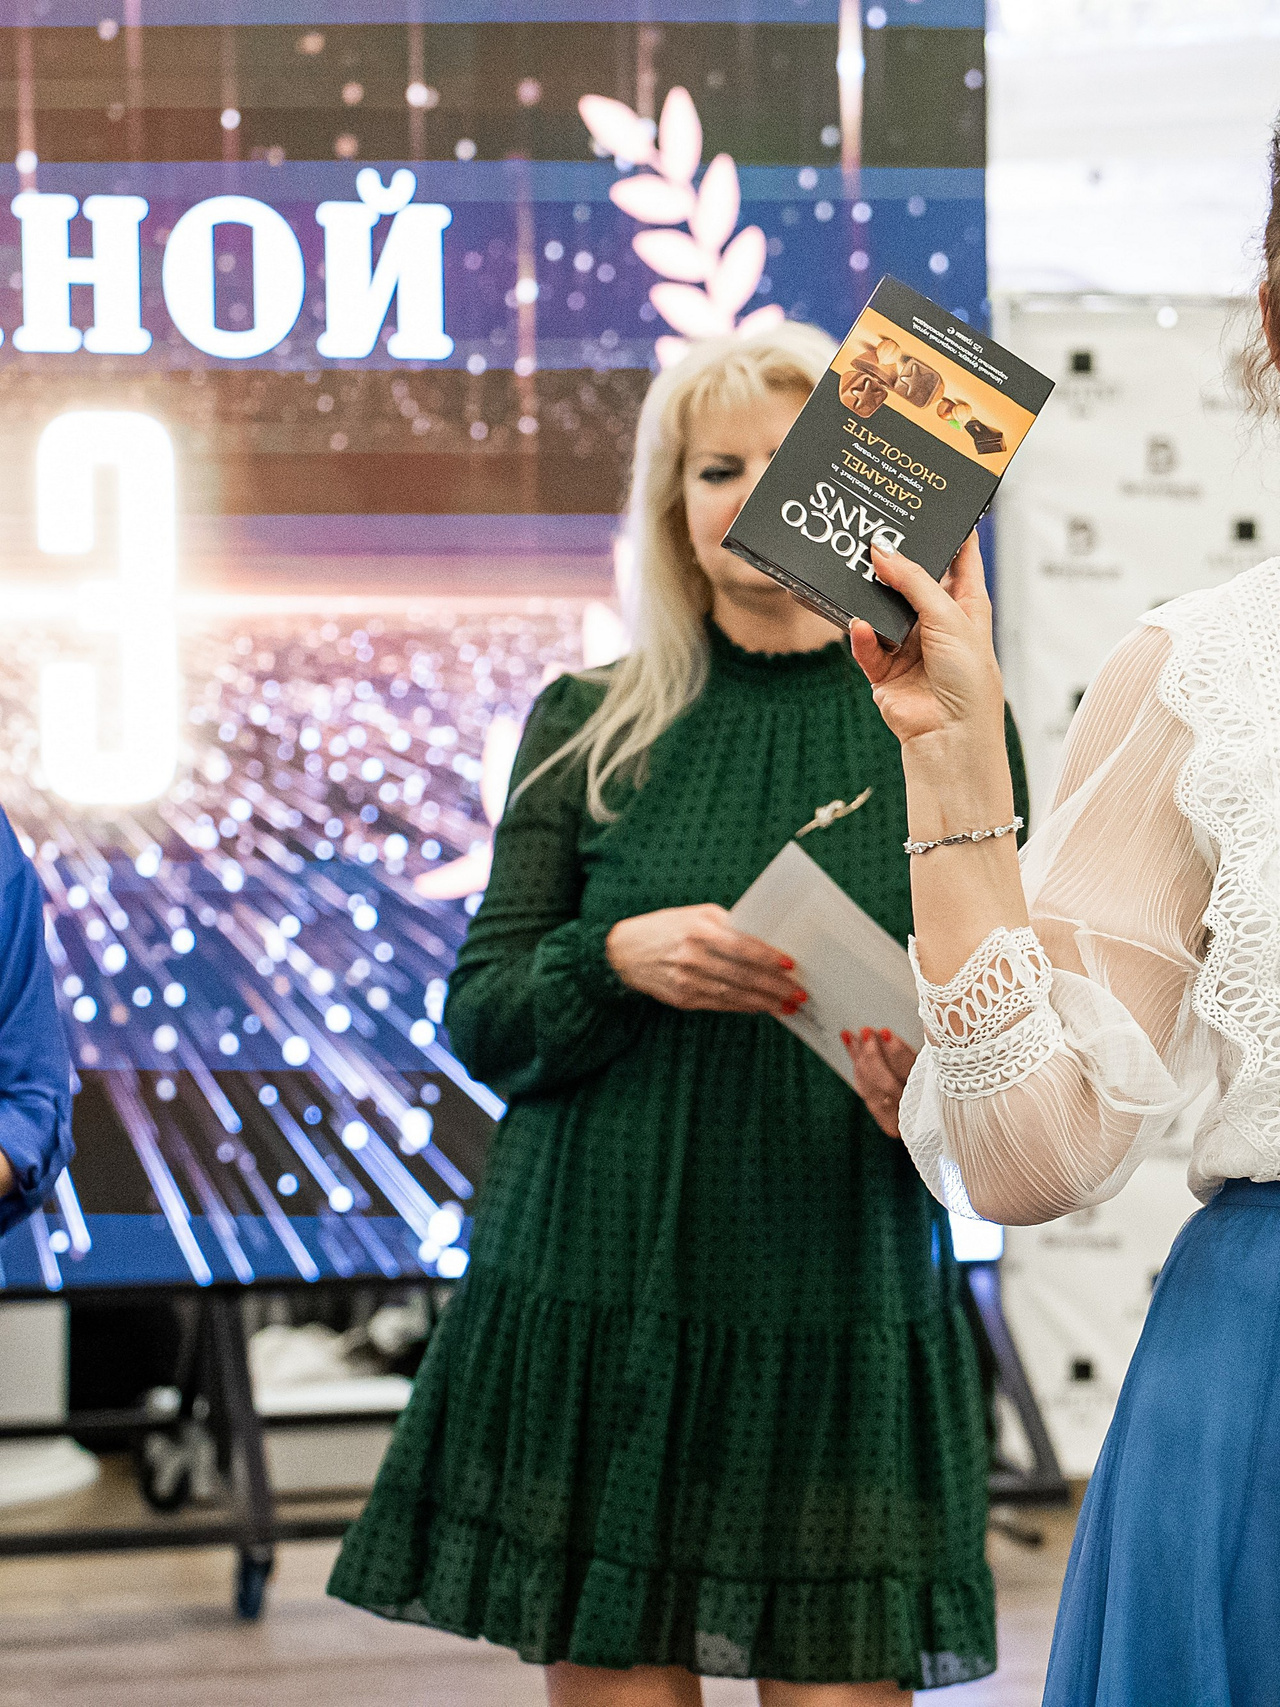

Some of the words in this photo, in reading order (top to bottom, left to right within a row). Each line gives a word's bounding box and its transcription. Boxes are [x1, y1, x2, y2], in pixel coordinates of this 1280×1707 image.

[0, 167, 454, 360] НОЙ
[972, 342, 983, 353] 125
[977, 365, 1003, 385] Цельный
[842, 417, 946, 490] CHOCOLATE
[851, 442, 880, 462] creamy
[830, 462, 839, 472] in
[880, 461, 897, 474] with
[839, 469, 872, 494] hazelnut
[841, 448, 922, 509] CARAMEL
[897, 472, 923, 492] topped
[872, 491, 908, 516] delicious
[780, 499, 882, 583] HOCO
